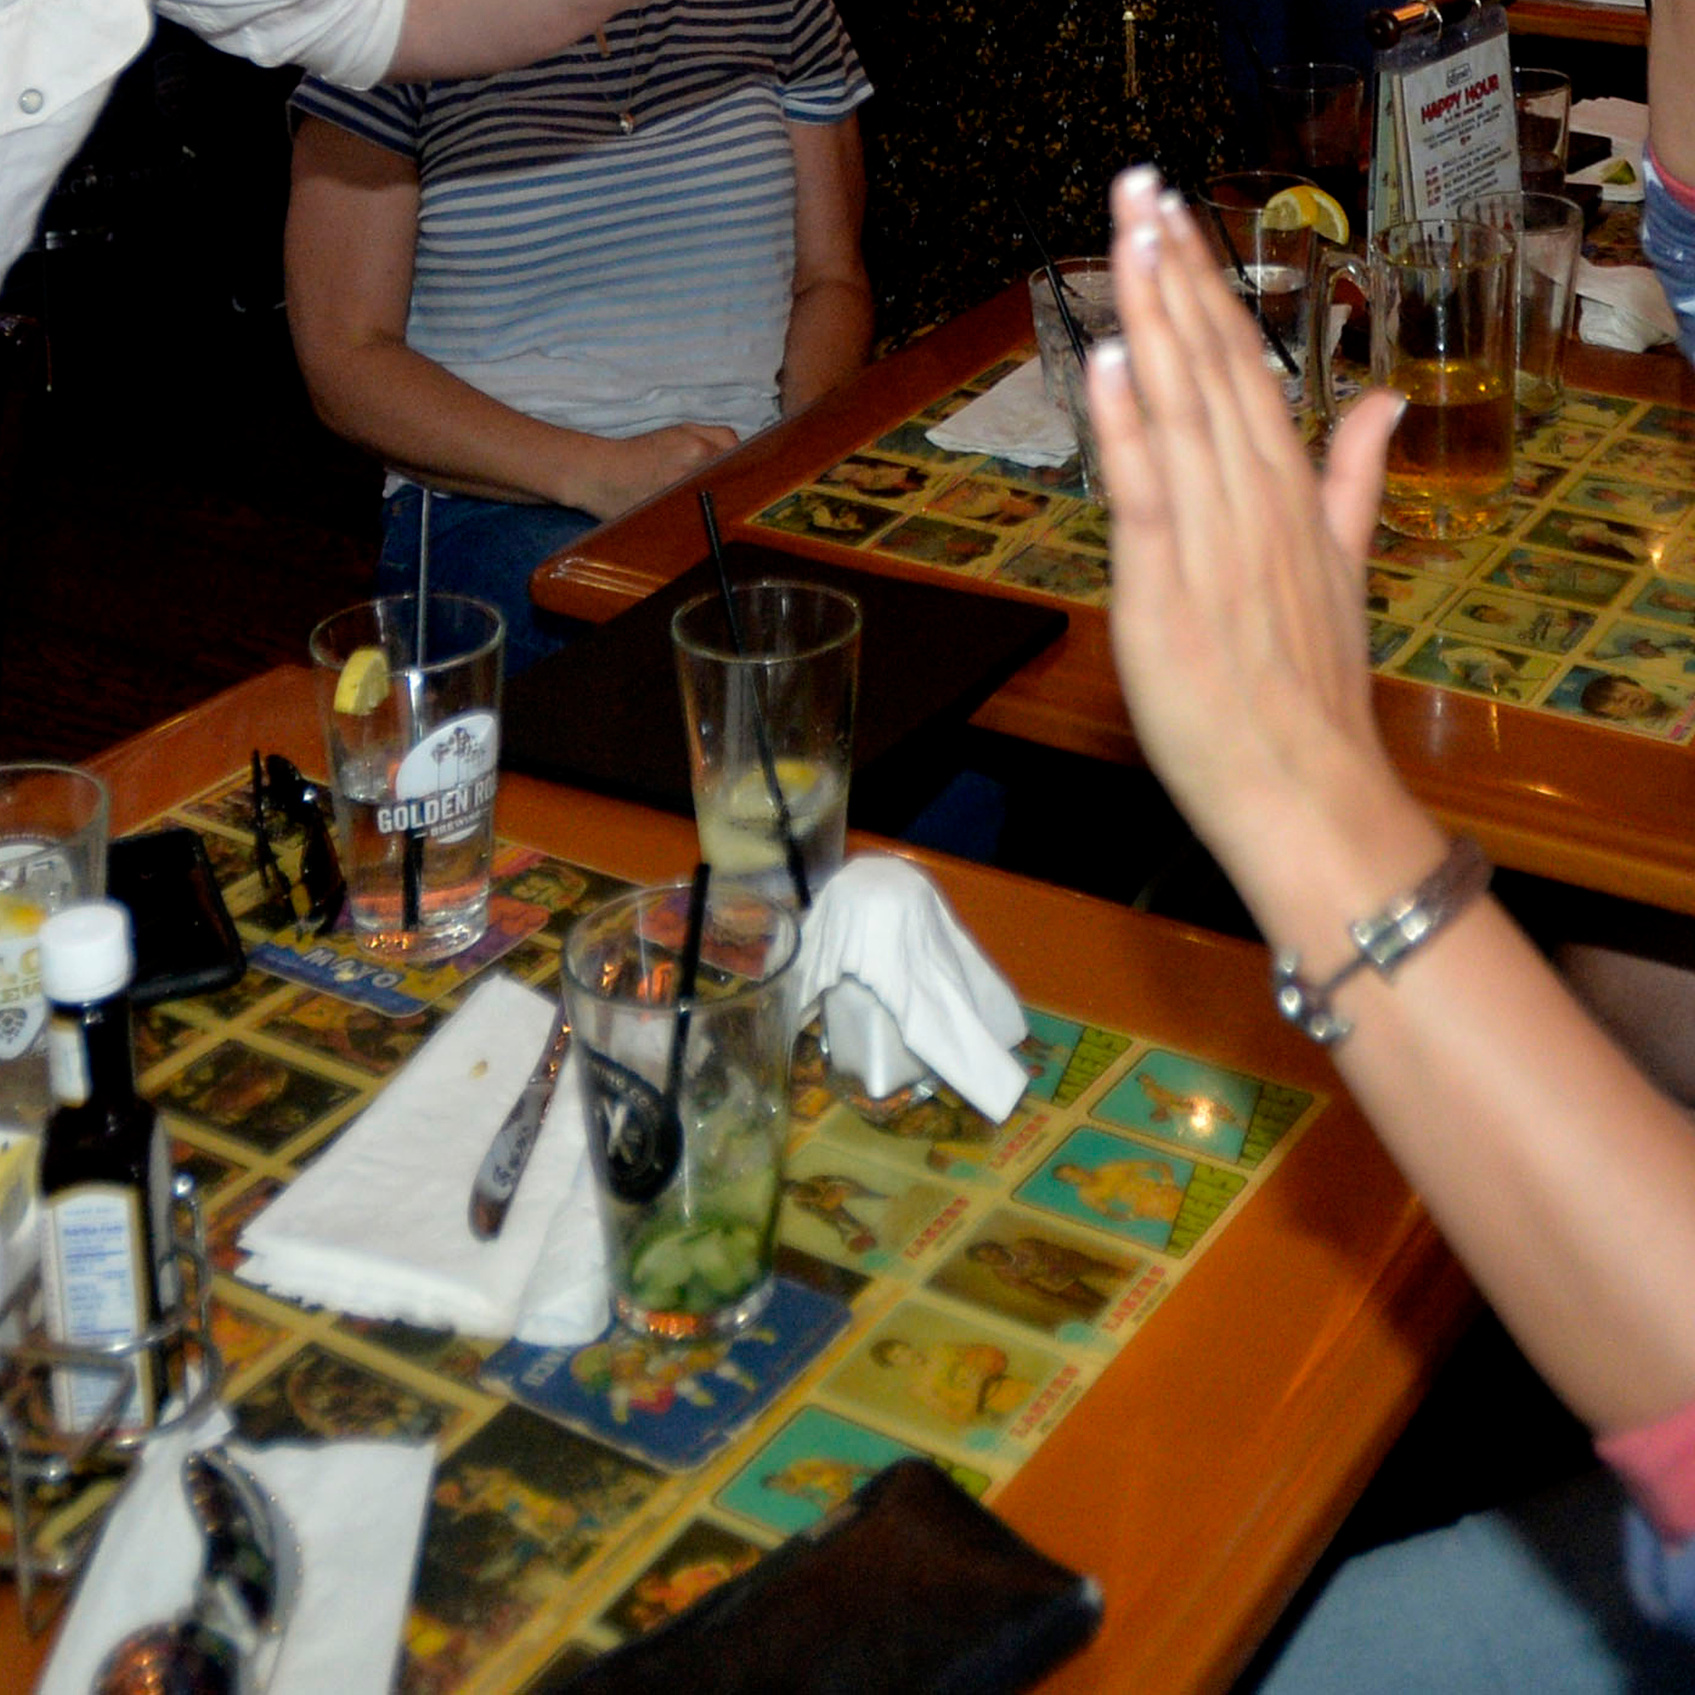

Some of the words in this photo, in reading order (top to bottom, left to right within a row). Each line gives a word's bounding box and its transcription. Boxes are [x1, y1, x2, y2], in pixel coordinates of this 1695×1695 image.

[1419, 90, 1463, 125] HAPPY
[1464, 73, 1500, 105] HOUR
[377, 782, 469, 835] GOLDEN
[303, 946, 402, 990] MAYO
